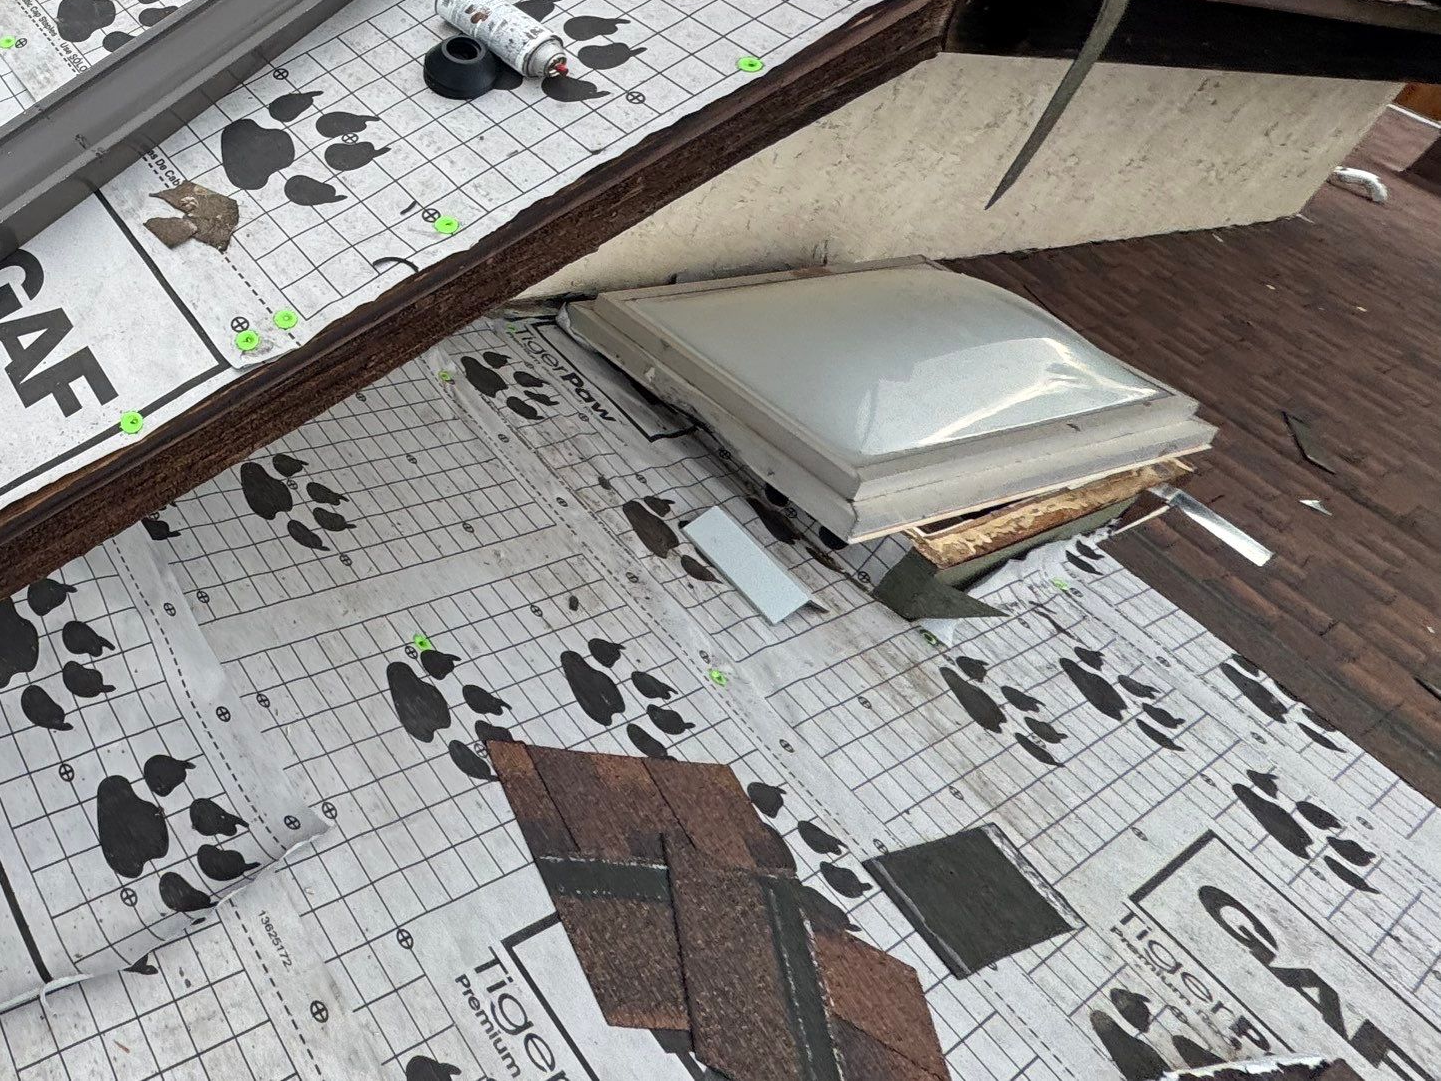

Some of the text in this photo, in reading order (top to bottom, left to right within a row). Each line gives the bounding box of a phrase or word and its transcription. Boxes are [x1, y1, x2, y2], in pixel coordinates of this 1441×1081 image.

[30, 5, 42, 19] Cap
[38, 15, 58, 37] Staples
[59, 41, 73, 55] Use
[164, 169, 181, 186] Cab
[515, 324, 617, 422] TigerPaw
[258, 909, 293, 973] 13625172
[1110, 925, 1192, 1006] Premium
[1118, 900, 1273, 1055] TigerP
[1198, 885, 1437, 1081] GAF
[454, 973, 522, 1079] Premium
[474, 945, 572, 1081] Tiger
